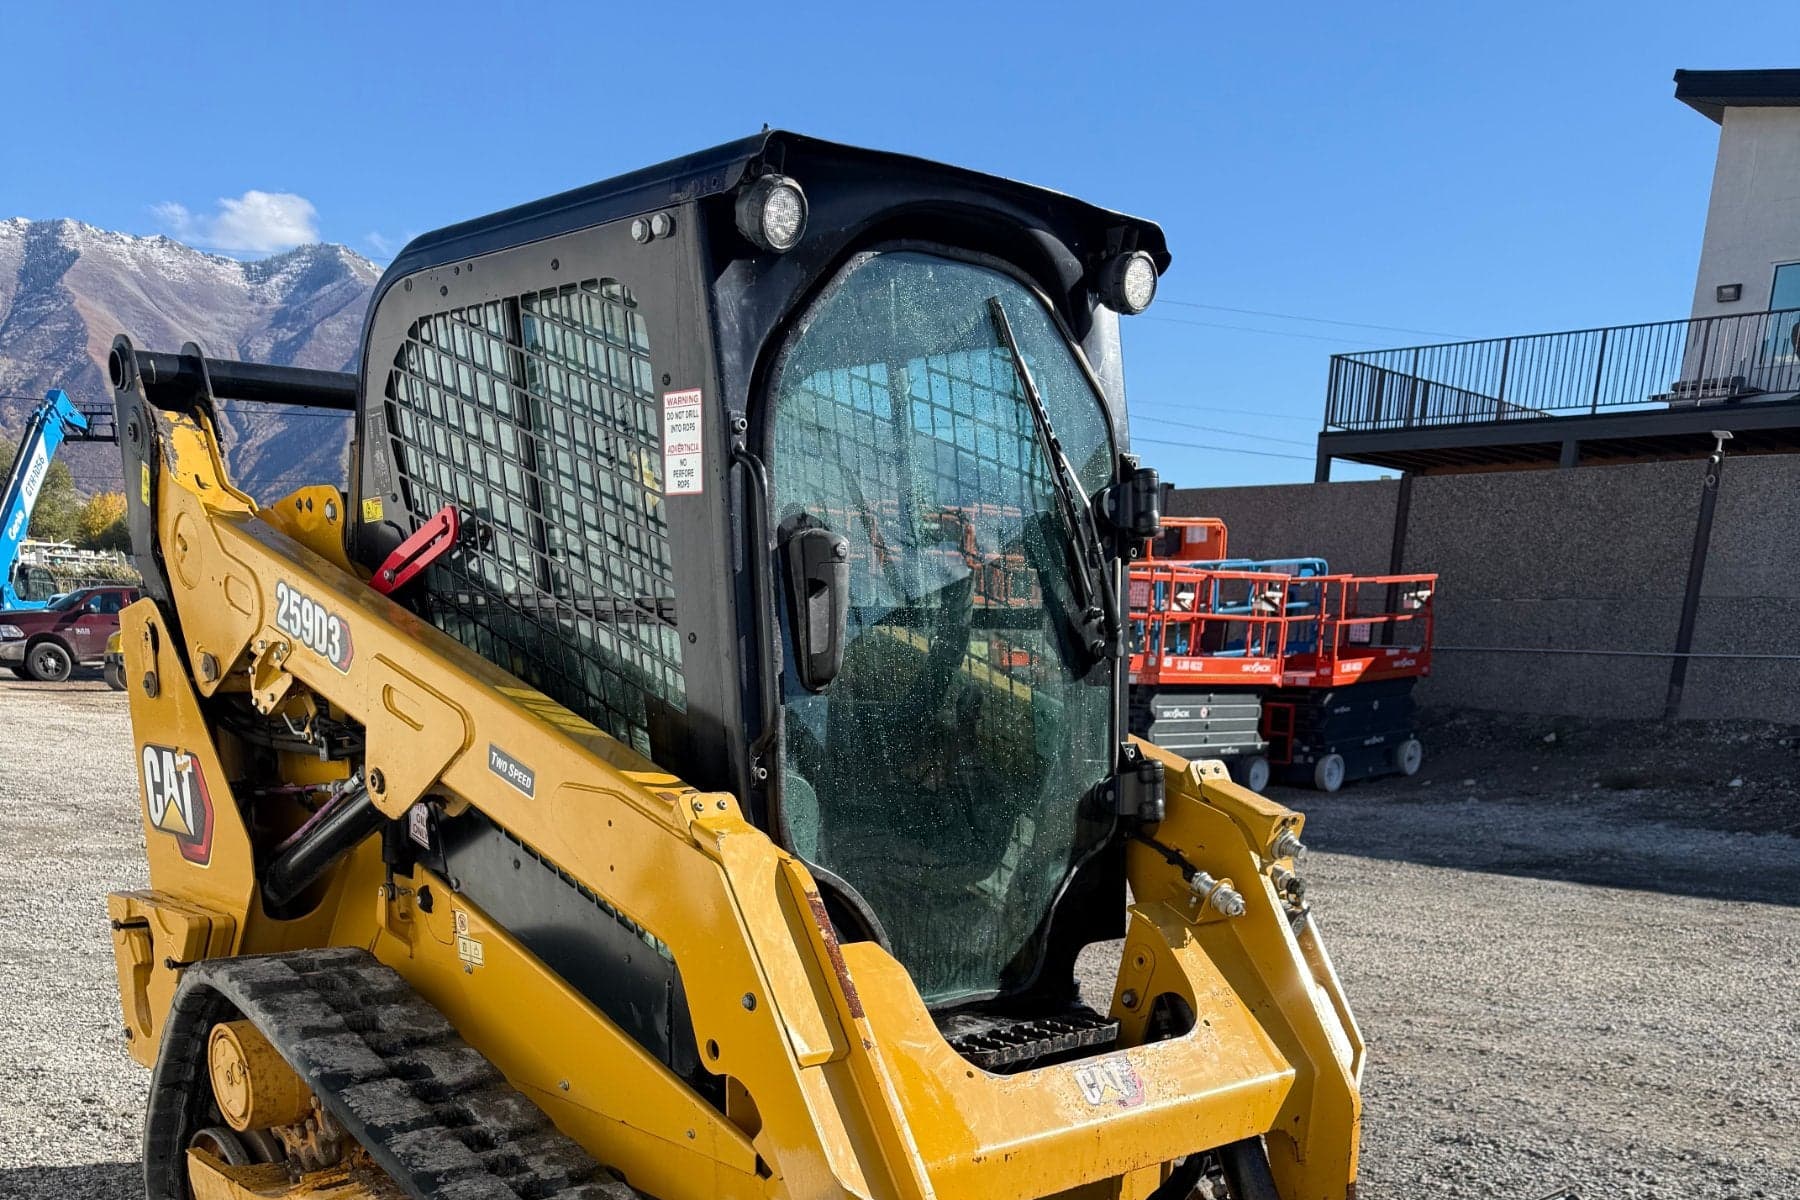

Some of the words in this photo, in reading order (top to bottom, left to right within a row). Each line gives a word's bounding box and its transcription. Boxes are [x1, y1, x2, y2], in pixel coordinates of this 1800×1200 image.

[667, 394, 699, 406] WARNING
[667, 411, 674, 420] DO
[675, 410, 685, 420] NOT
[686, 409, 699, 419] DRILL
[671, 424, 682, 433] INTO
[683, 422, 695, 432] ROPS
[680, 458, 687, 467] NO
[25, 456, 45, 497] GTH-1056
[677, 479, 690, 488] ROPS
[9, 510, 24, 540] Genie
[277, 582, 341, 663] 259D3
[508, 763, 531, 788] SPEED
[143, 746, 195, 837] CAT
[1074, 1057, 1130, 1106] CAT
